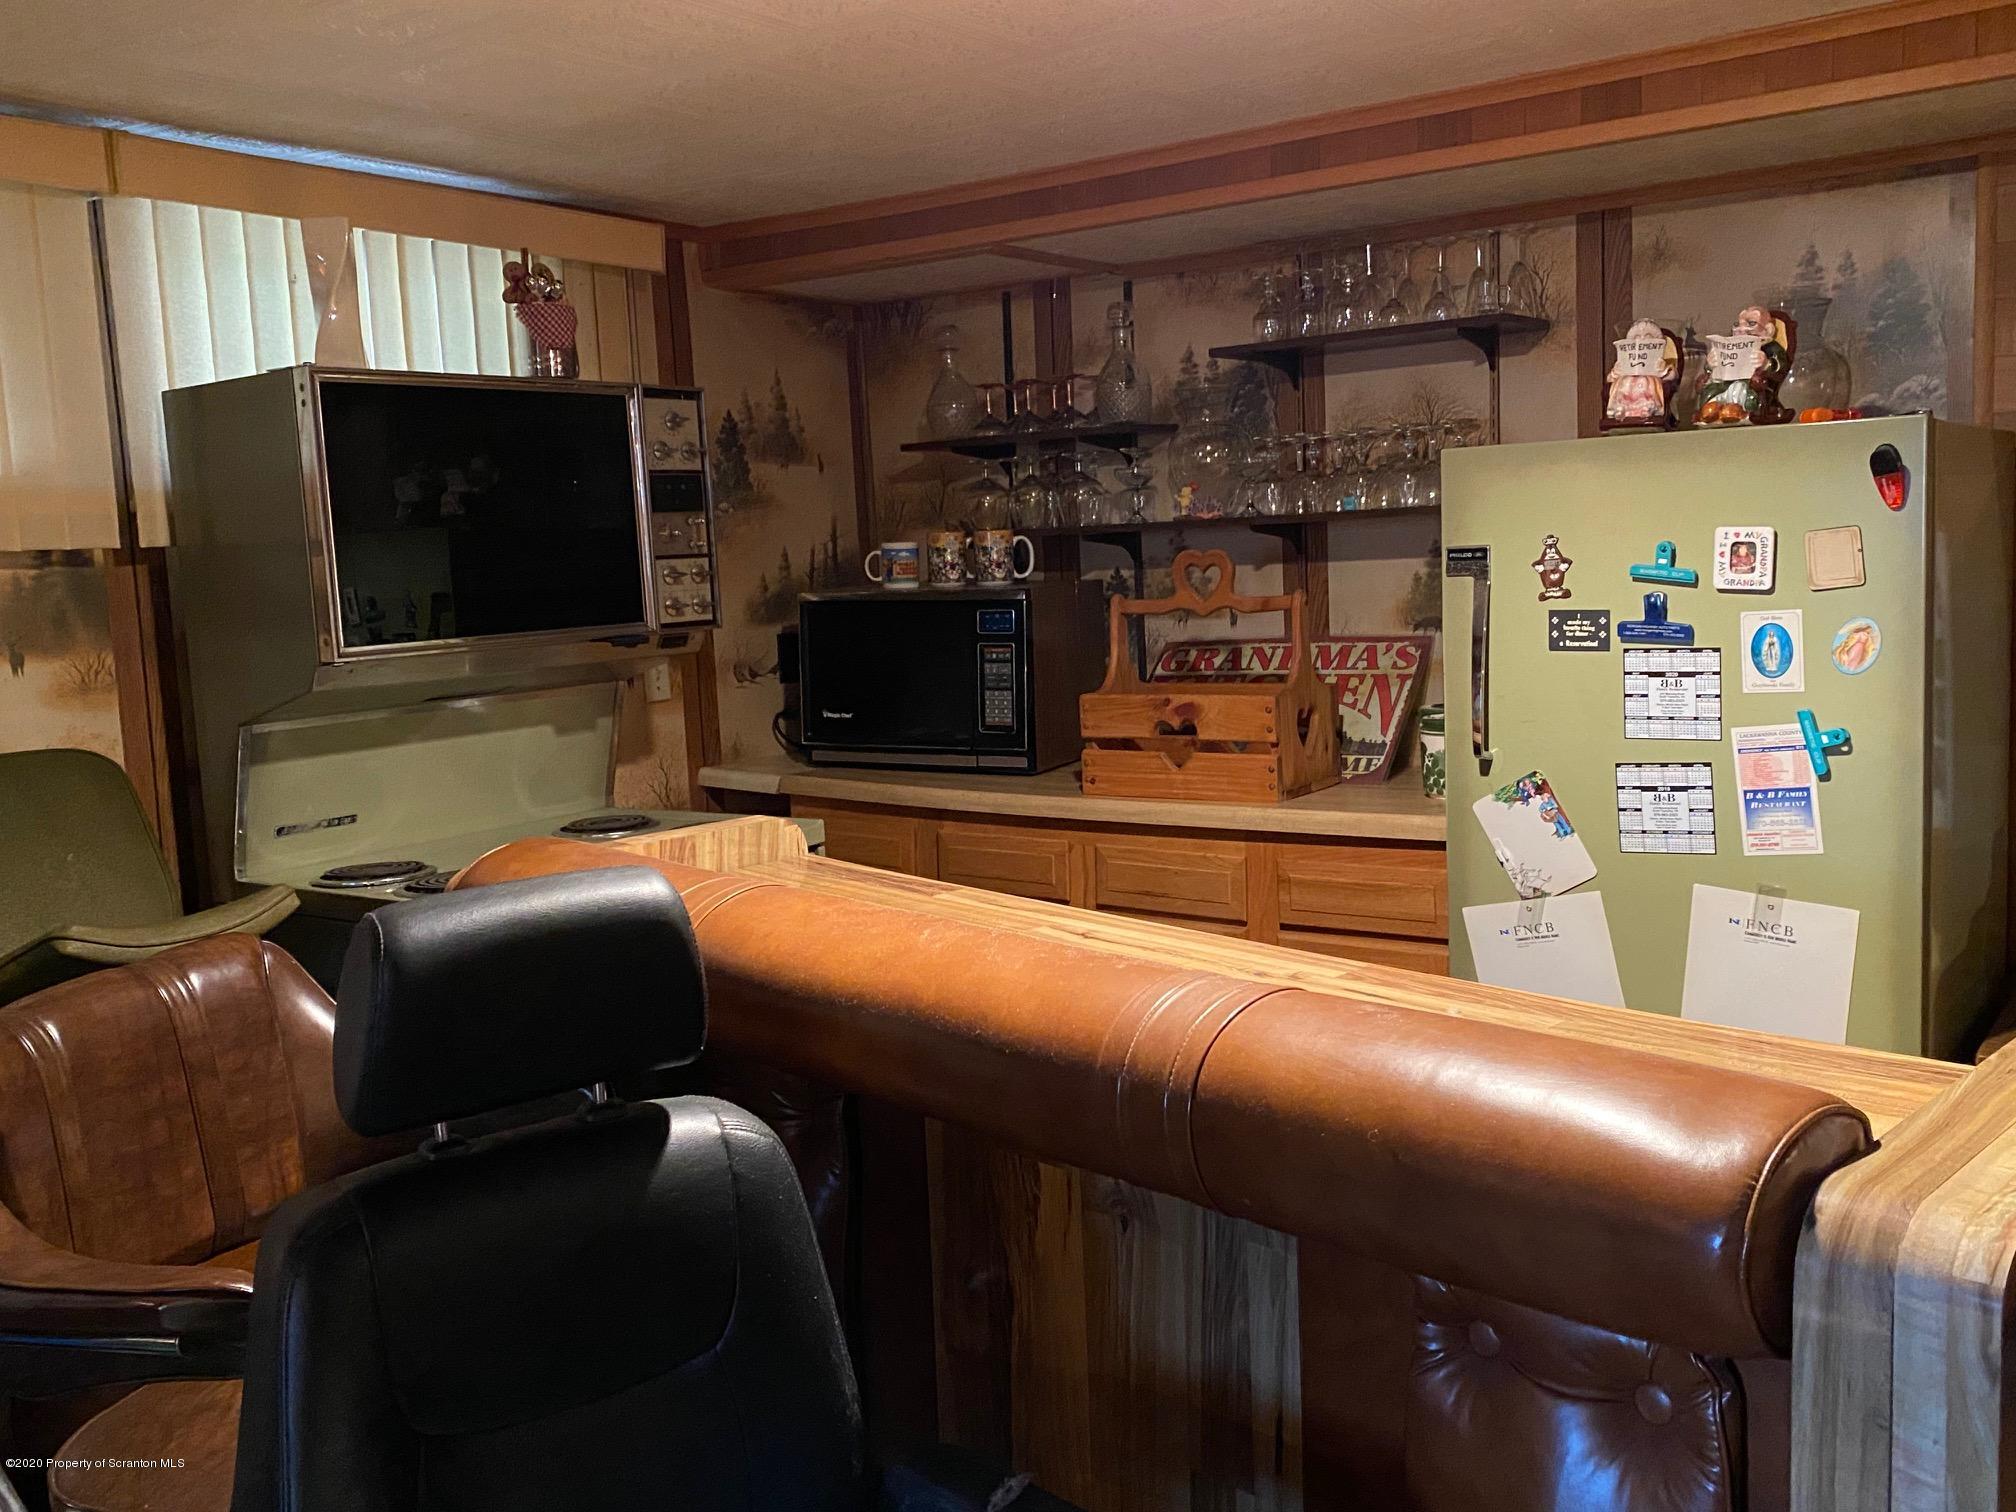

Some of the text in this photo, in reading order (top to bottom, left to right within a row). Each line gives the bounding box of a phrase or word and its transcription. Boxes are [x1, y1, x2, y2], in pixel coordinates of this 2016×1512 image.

[1618, 343, 1664, 352] RETIREMENT
[1628, 353, 1648, 361] FUND
[1720, 352, 1738, 361] FUND
[1513, 922, 1555, 936] FNCB
[1745, 918, 1794, 937] FNCB
